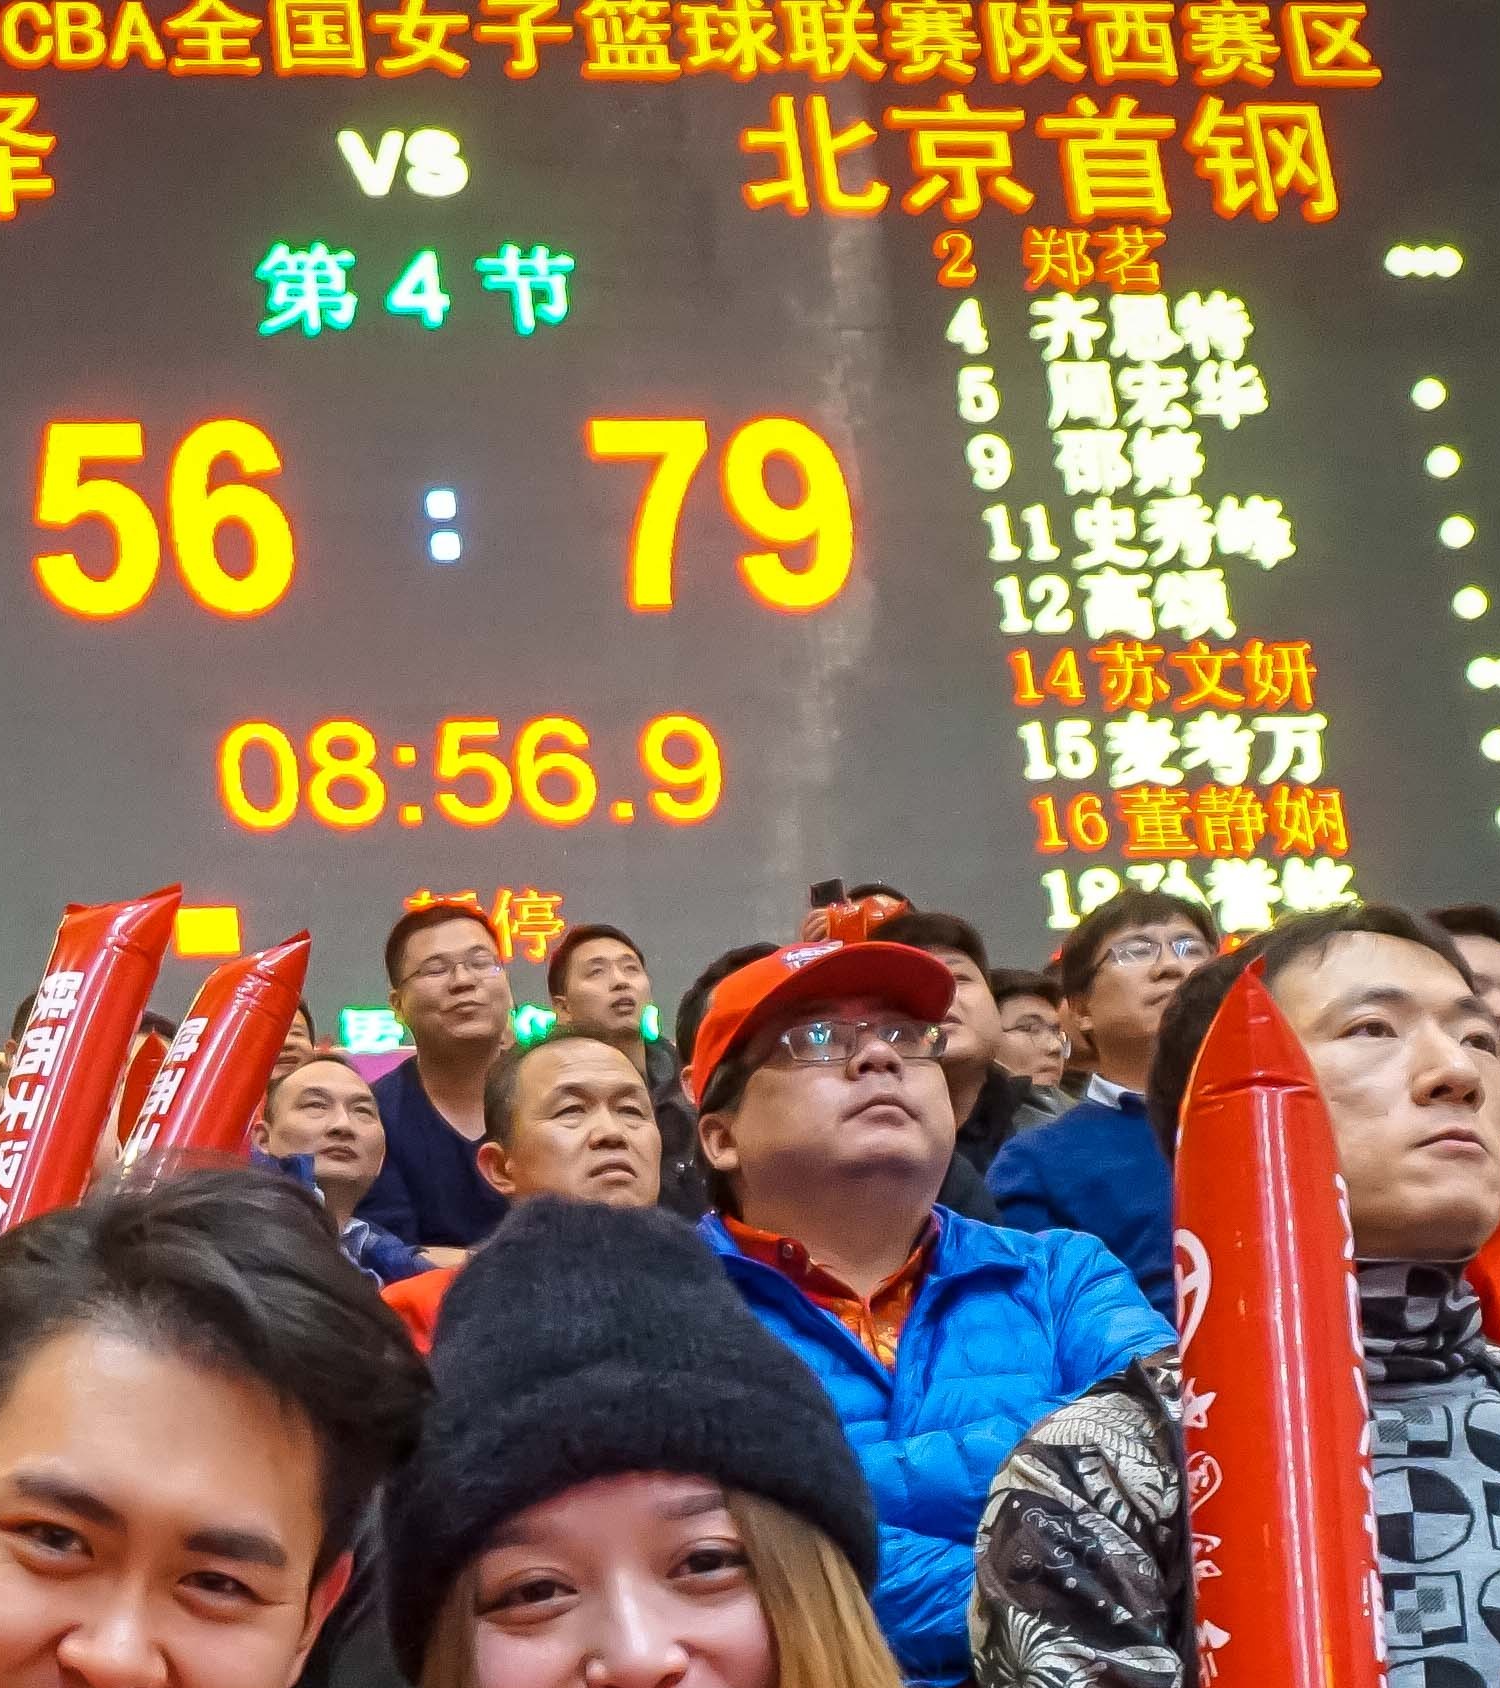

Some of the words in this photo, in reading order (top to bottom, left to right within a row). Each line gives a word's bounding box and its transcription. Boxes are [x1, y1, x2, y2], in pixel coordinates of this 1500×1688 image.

[740, 84, 1340, 225] 北京首钢
[934, 230, 976, 287] 2
[1023, 225, 1166, 294] 郑茗
[947, 298, 988, 354] 4
[958, 367, 999, 422] 5
[967, 434, 1012, 489] 9
[31, 415, 298, 623] 56
[583, 412, 860, 616] 79
[983, 504, 1060, 561] 11
[994, 575, 1073, 632] 12
[1008, 647, 1085, 707] 14
[1090, 638, 1317, 713] 苏文妍
[216, 710, 726, 835] 08:56.9
[1018, 720, 1097, 779] 15
[1030, 792, 1109, 853] 16
